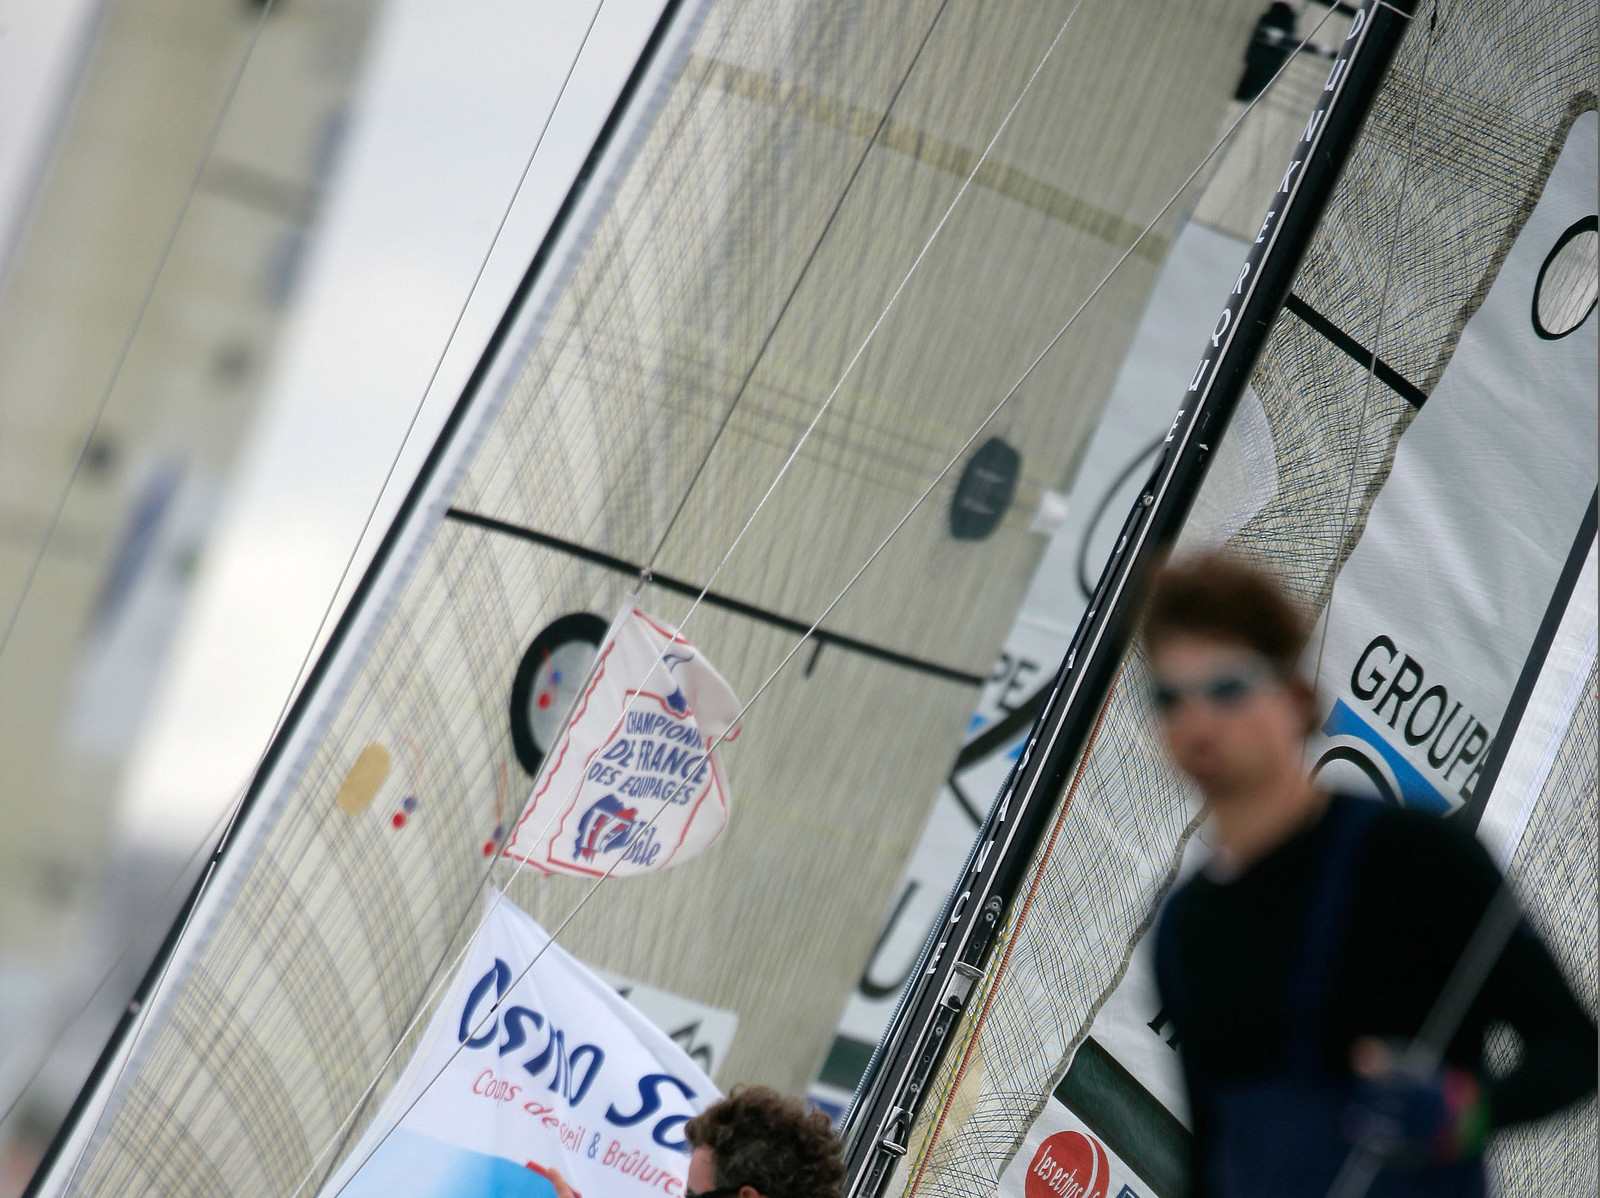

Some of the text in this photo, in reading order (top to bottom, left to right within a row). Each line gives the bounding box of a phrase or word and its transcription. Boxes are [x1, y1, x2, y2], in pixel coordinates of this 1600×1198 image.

[1165, 8, 1366, 443] DUNKERQUE
[602, 738, 710, 784] DE FRANCE
[587, 762, 696, 806] DES EQUIPAGES
[587, 1132, 602, 1159] &
